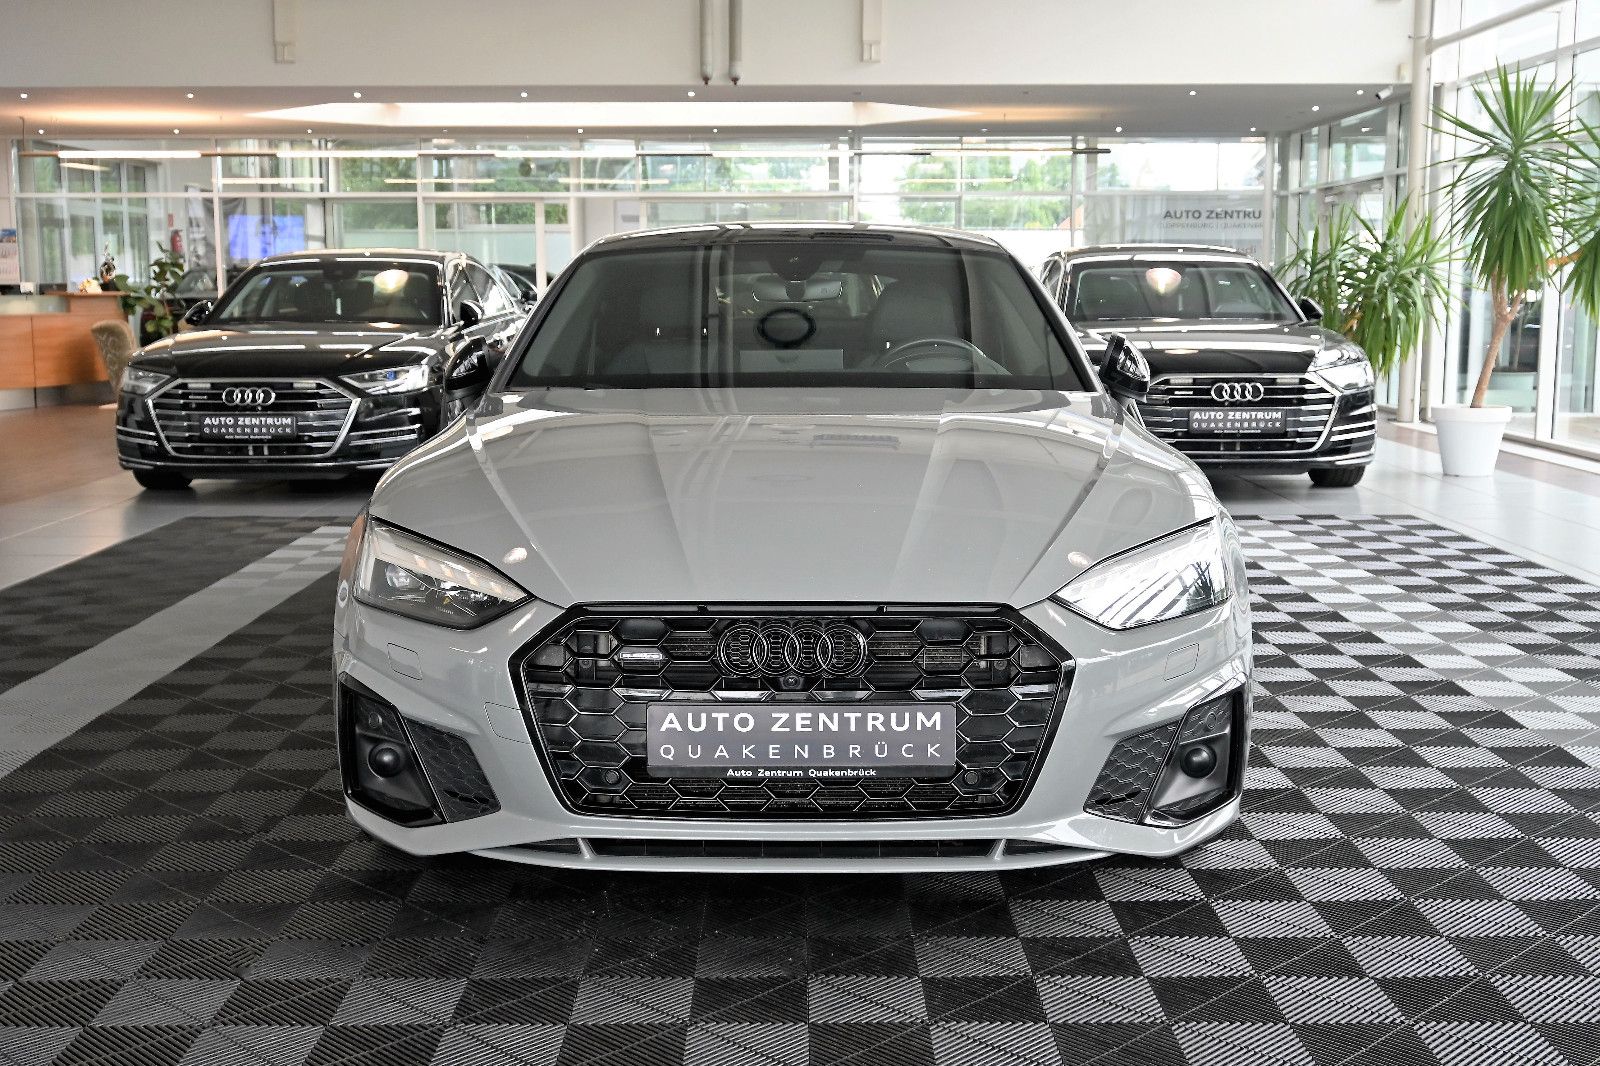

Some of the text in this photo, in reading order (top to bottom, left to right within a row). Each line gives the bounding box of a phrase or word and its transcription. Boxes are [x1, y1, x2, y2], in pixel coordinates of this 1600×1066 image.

[1163, 209, 1262, 220] AUTO ZENTRU
[1193, 411, 1282, 420] AUTO ZENTRUM
[204, 417, 292, 425] AUTO ZENTRUM
[660, 712, 941, 732] AUTO ZENTRUM
[660, 741, 941, 760] QUAKENBRÜCK
[726, 768, 877, 777] Auto Zentrum Quakenbrück
